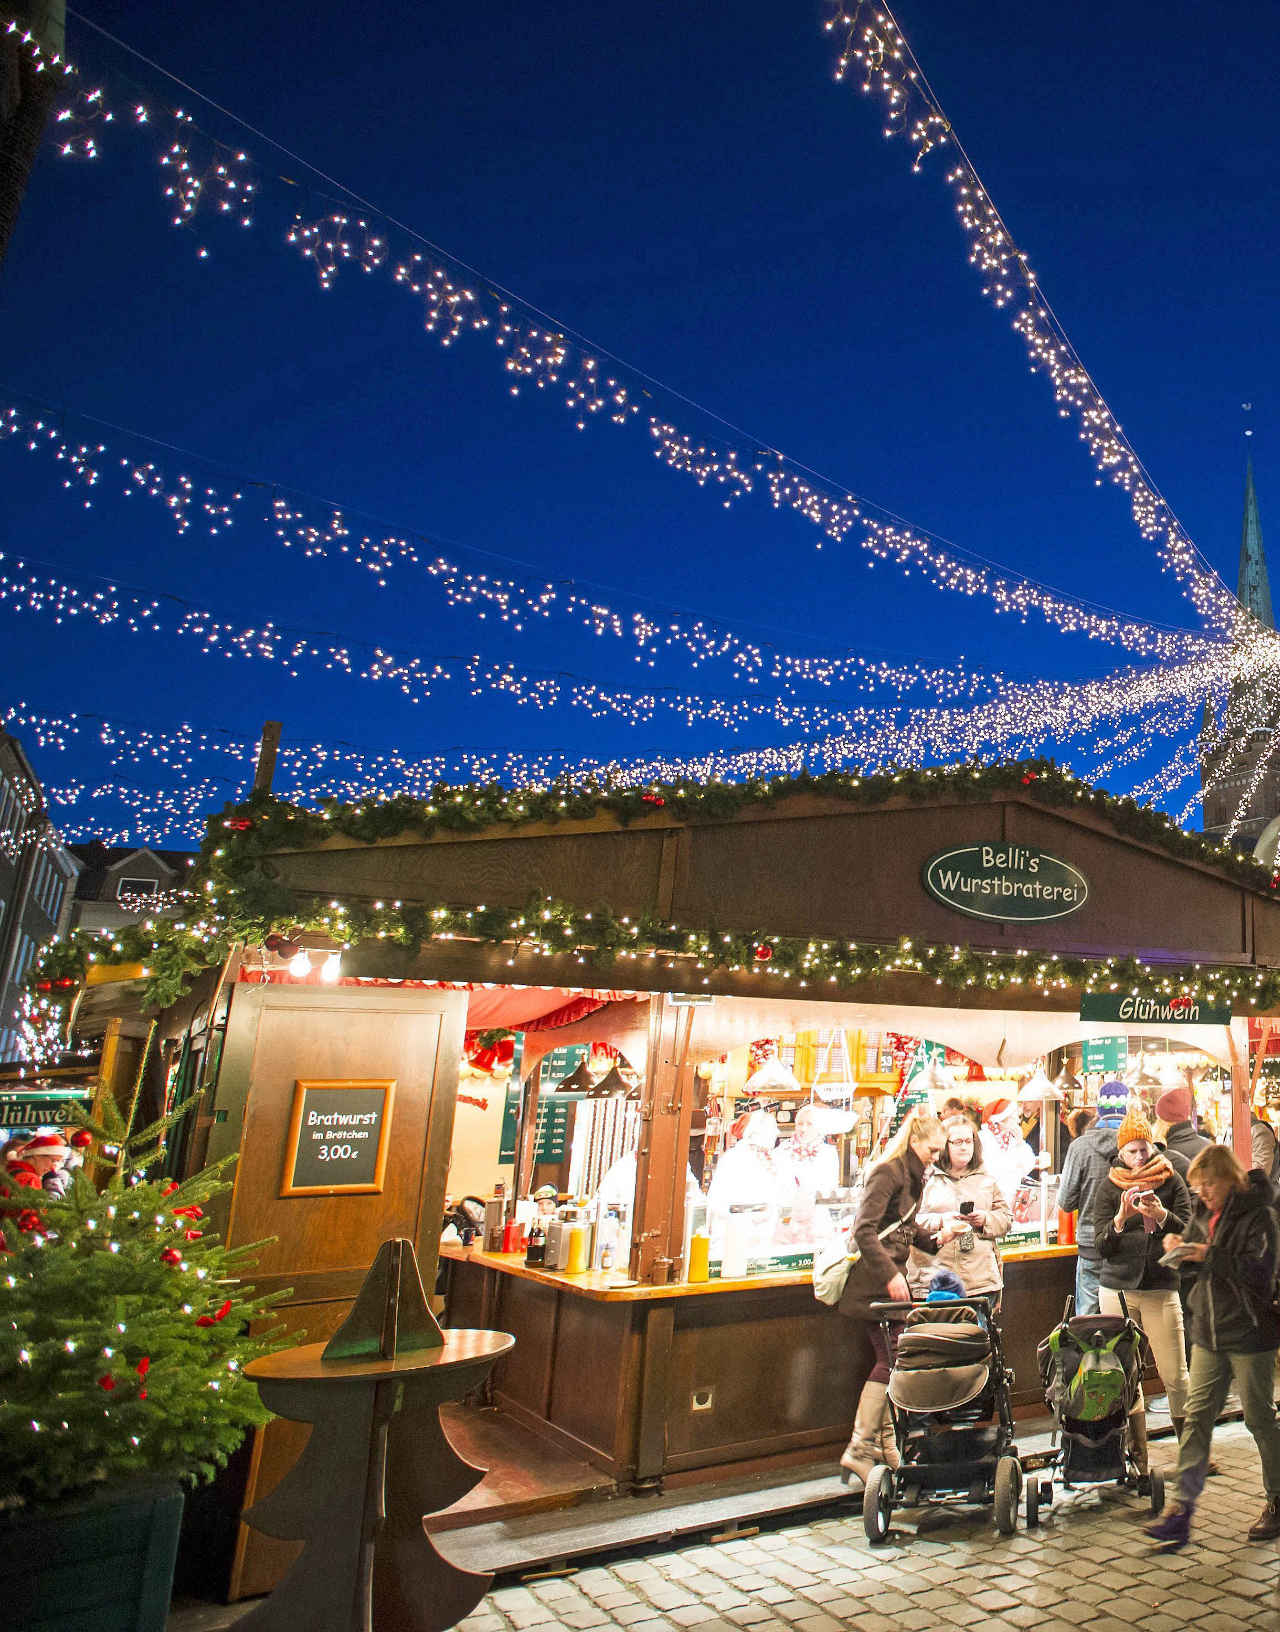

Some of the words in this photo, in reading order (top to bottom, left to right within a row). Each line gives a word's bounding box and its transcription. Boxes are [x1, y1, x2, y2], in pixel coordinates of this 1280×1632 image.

[982, 846, 1040, 873] Belli's
[938, 869, 1079, 902] Wurstbraterei
[1119, 997, 1200, 1021] Glühwein
[0, 1103, 77, 1125] lühwei
[307, 1110, 378, 1126] Bratwurst
[312, 1131, 324, 1140] im
[326, 1130, 369, 1140] Brötchen
[318, 1144, 359, 1161] 3,00€
